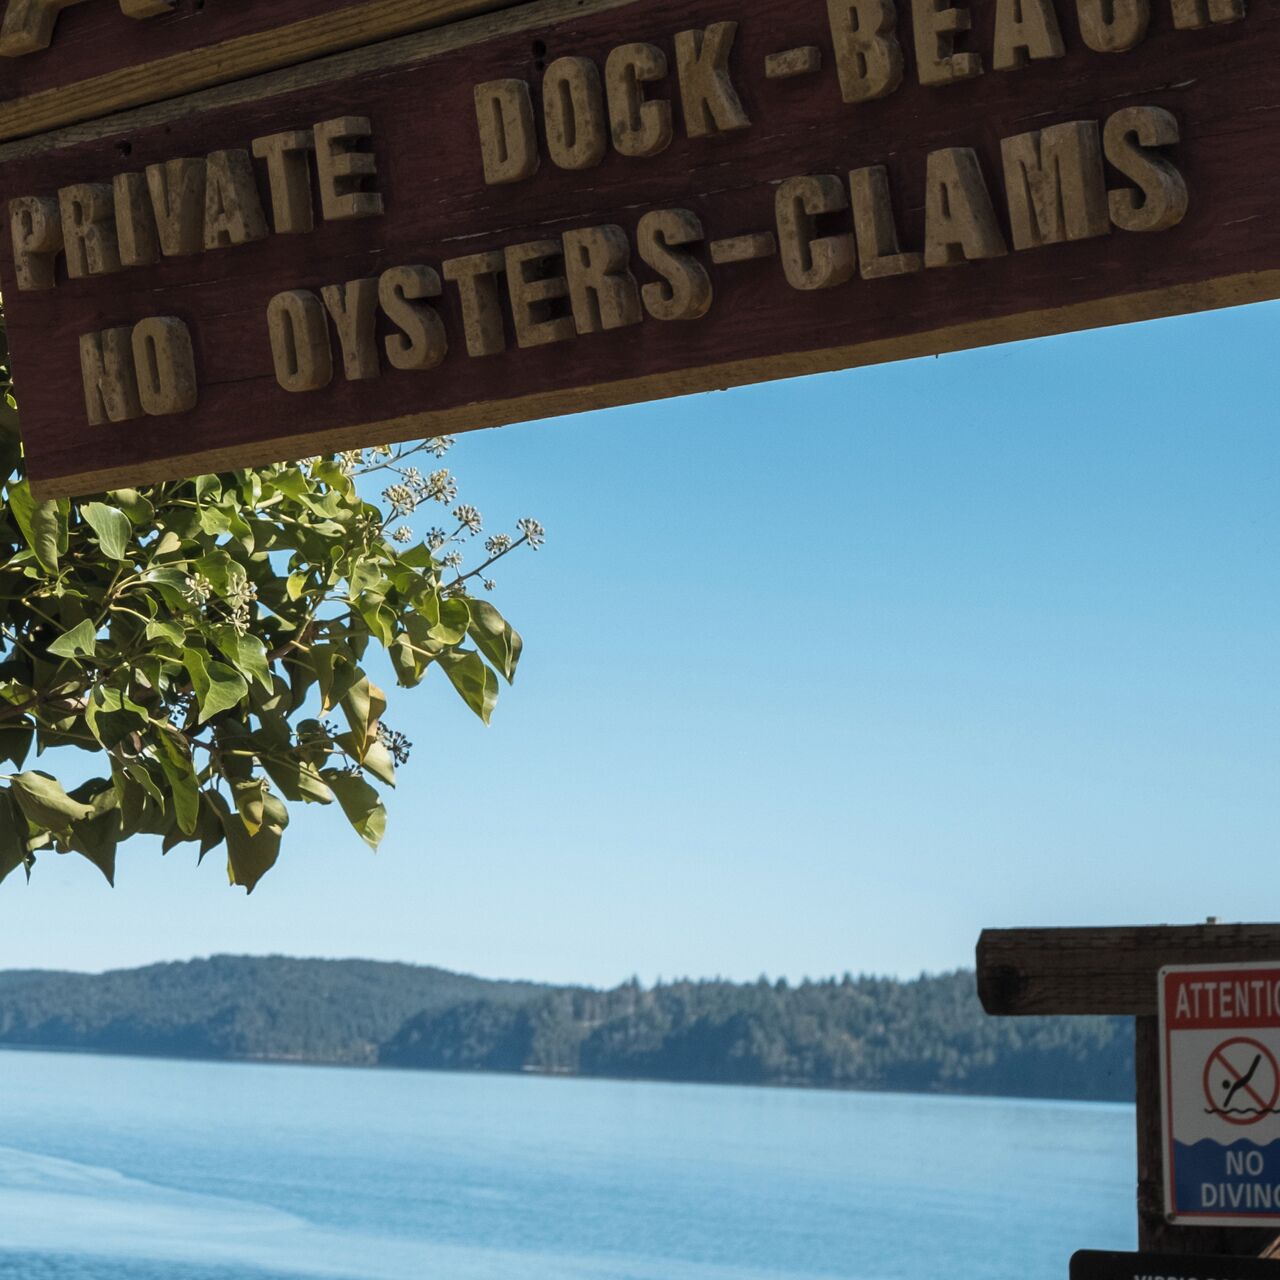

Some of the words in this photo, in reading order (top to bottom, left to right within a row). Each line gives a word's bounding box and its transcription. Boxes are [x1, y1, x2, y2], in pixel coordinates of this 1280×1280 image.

[8, 116, 384, 291] PRIVATE
[79, 315, 198, 426] NO
[266, 105, 1188, 393] OYSTERS-CLAMS
[1226, 1150, 1264, 1176] NO
